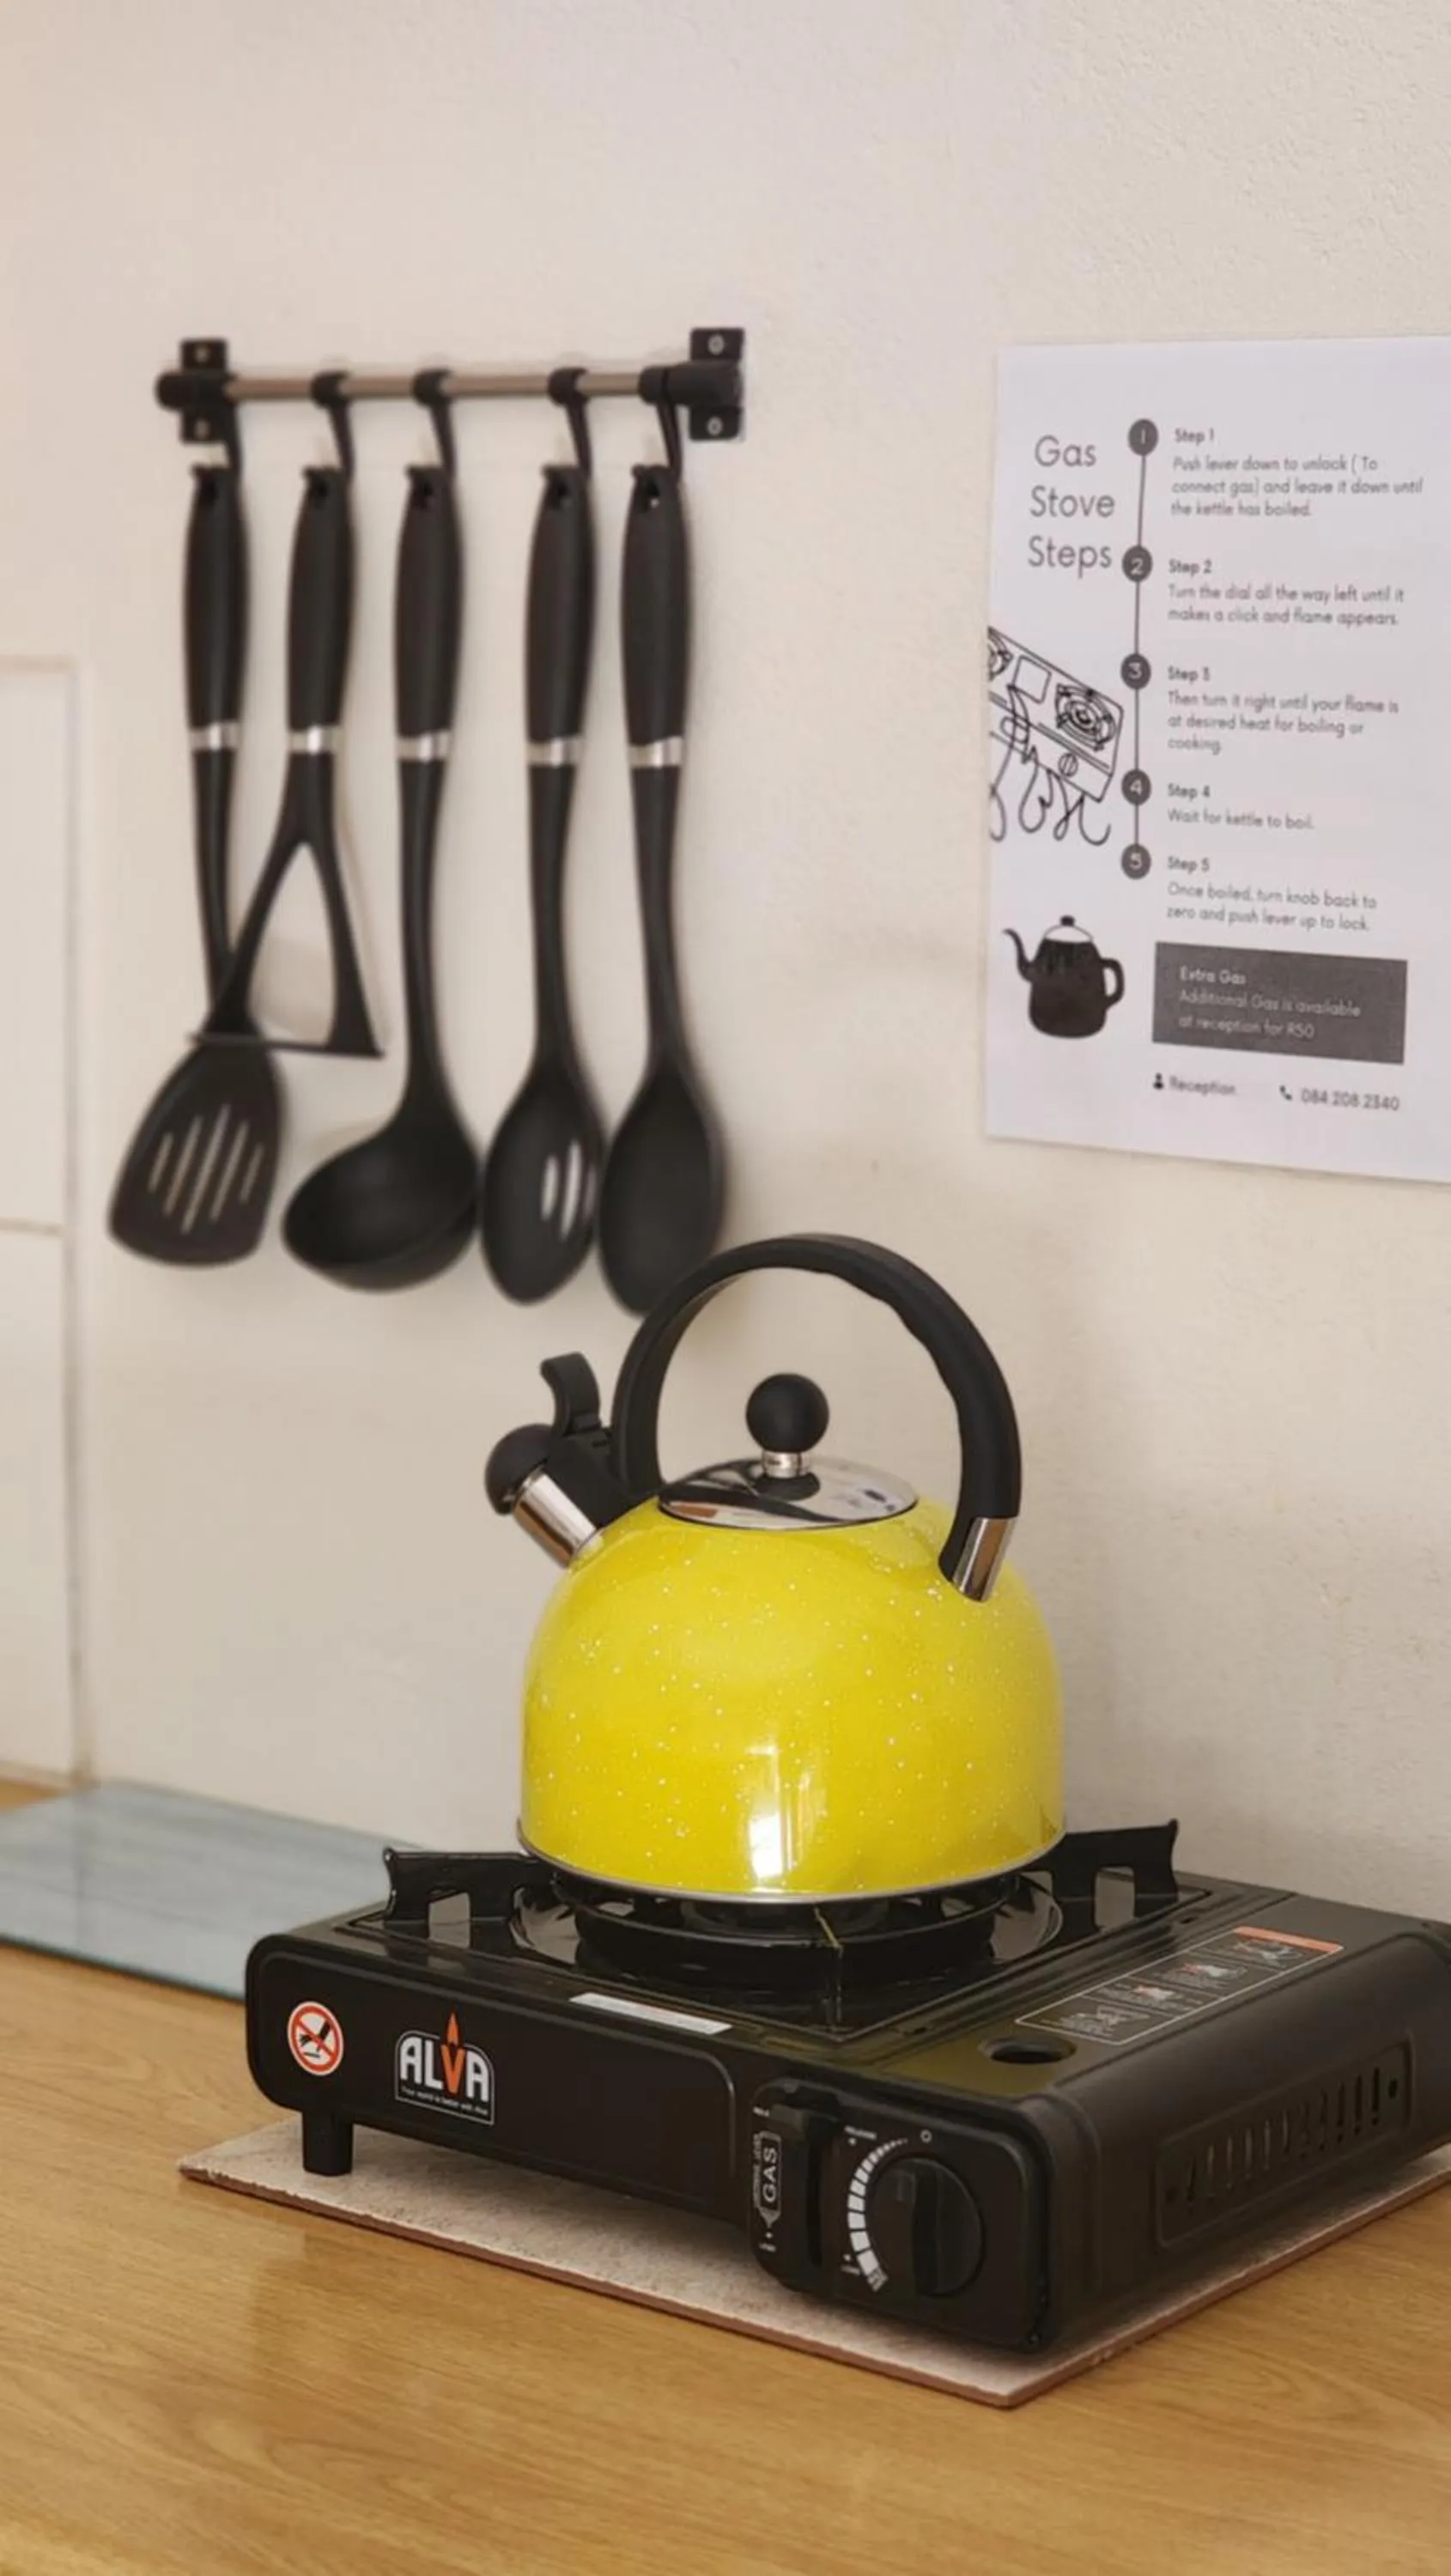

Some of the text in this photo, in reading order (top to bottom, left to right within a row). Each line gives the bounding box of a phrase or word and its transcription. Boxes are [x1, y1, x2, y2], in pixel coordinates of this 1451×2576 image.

[1141, 429, 1146, 445] 1
[1175, 428, 1214, 447] Step 1
[1035, 434, 1097, 467] Gas
[1173, 455, 1200, 471] Push
[1206, 454, 1238, 471] lever
[1242, 454, 1279, 471] down
[1284, 458, 1298, 471] to
[1302, 453, 1347, 471] unlock
[1361, 455, 1378, 471] To
[1172, 477, 1424, 498] connect gas) and leave it down until
[1029, 485, 1115, 518] Stove
[1171, 499, 1311, 516] the kettle has boiled.
[1028, 535, 1112, 579] Steps
[1130, 558, 1144, 575] 2
[1169, 558, 1212, 577] Step 2
[1169, 582, 1405, 605] Turn the dial all the way left until it
[1168, 605, 1210, 622] makes
[1214, 611, 1223, 623] a
[1228, 605, 1259, 623] click
[1263, 607, 1290, 623] and
[1294, 606, 1333, 623] flame
[1128, 662, 1142, 679] 3
[1168, 665, 1210, 685] Step 3
[1169, 690, 1399, 714] Then turn it right until your flame is
[1168, 714, 1363, 739] at desired heat for boiling or
[1130, 780, 1142, 795] 4
[1168, 783, 1211, 801] Step 4
[1168, 808, 1199, 823] Wait
[1204, 808, 1222, 824] for
[1226, 809, 1263, 827] kettle
[1267, 814, 1282, 828] to
[1130, 853, 1142, 869] 5
[1168, 856, 1210, 875] Step 5
[1168, 881, 1203, 897] Once
[1257, 889, 1283, 902] turn
[1286, 885, 1320, 905] knob
[1324, 889, 1358, 907] back
[1363, 896, 1377, 908] to
[1167, 908, 1196, 920] zero
[1199, 904, 1225, 921] and
[1229, 907, 1259, 927] push
[1262, 908, 1296, 926] lever
[1299, 917, 1317, 933] up
[1320, 915, 1334, 928] to
[1180, 966, 1246, 985] Extra Gas
[1179, 989, 1361, 1017] Additional Gas is available
[1179, 1015, 1314, 1038] at reception for R50
[1169, 1076, 1236, 1096] Reception
[400, 2036, 489, 2102] ALVA
[762, 2148, 778, 2202] GAS
